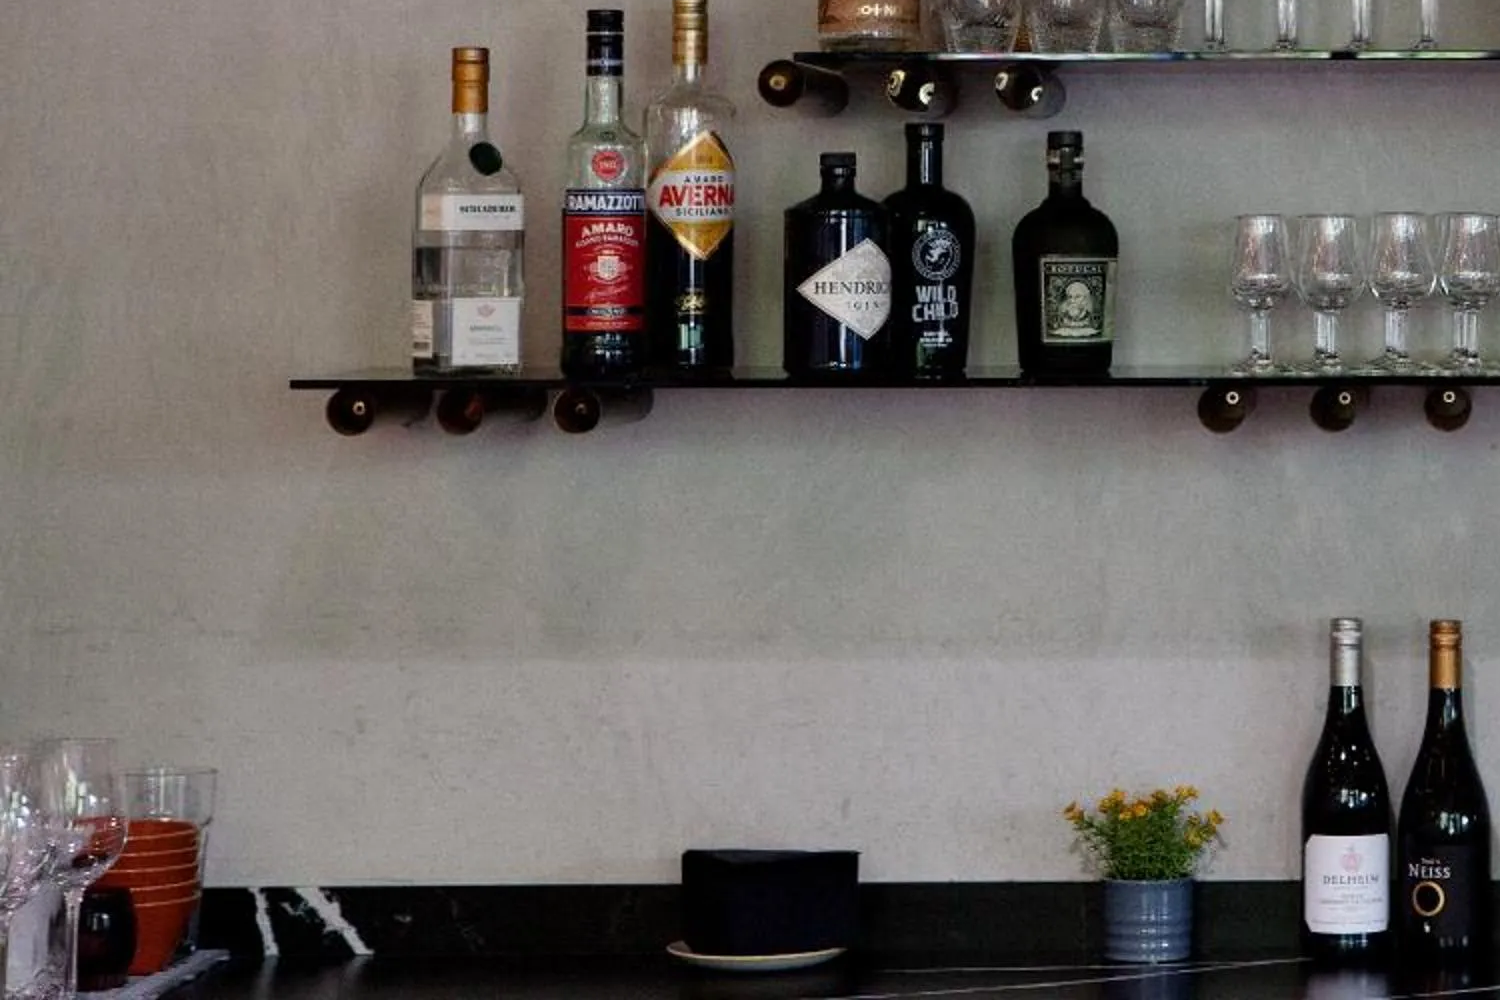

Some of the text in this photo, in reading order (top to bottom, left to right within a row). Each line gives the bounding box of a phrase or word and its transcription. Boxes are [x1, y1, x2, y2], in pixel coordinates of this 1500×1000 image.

[567, 195, 645, 211] RAMAZZOTT
[915, 285, 957, 303] WILD
[912, 302, 959, 323] CHILD
[1408, 863, 1451, 879] NEISS
